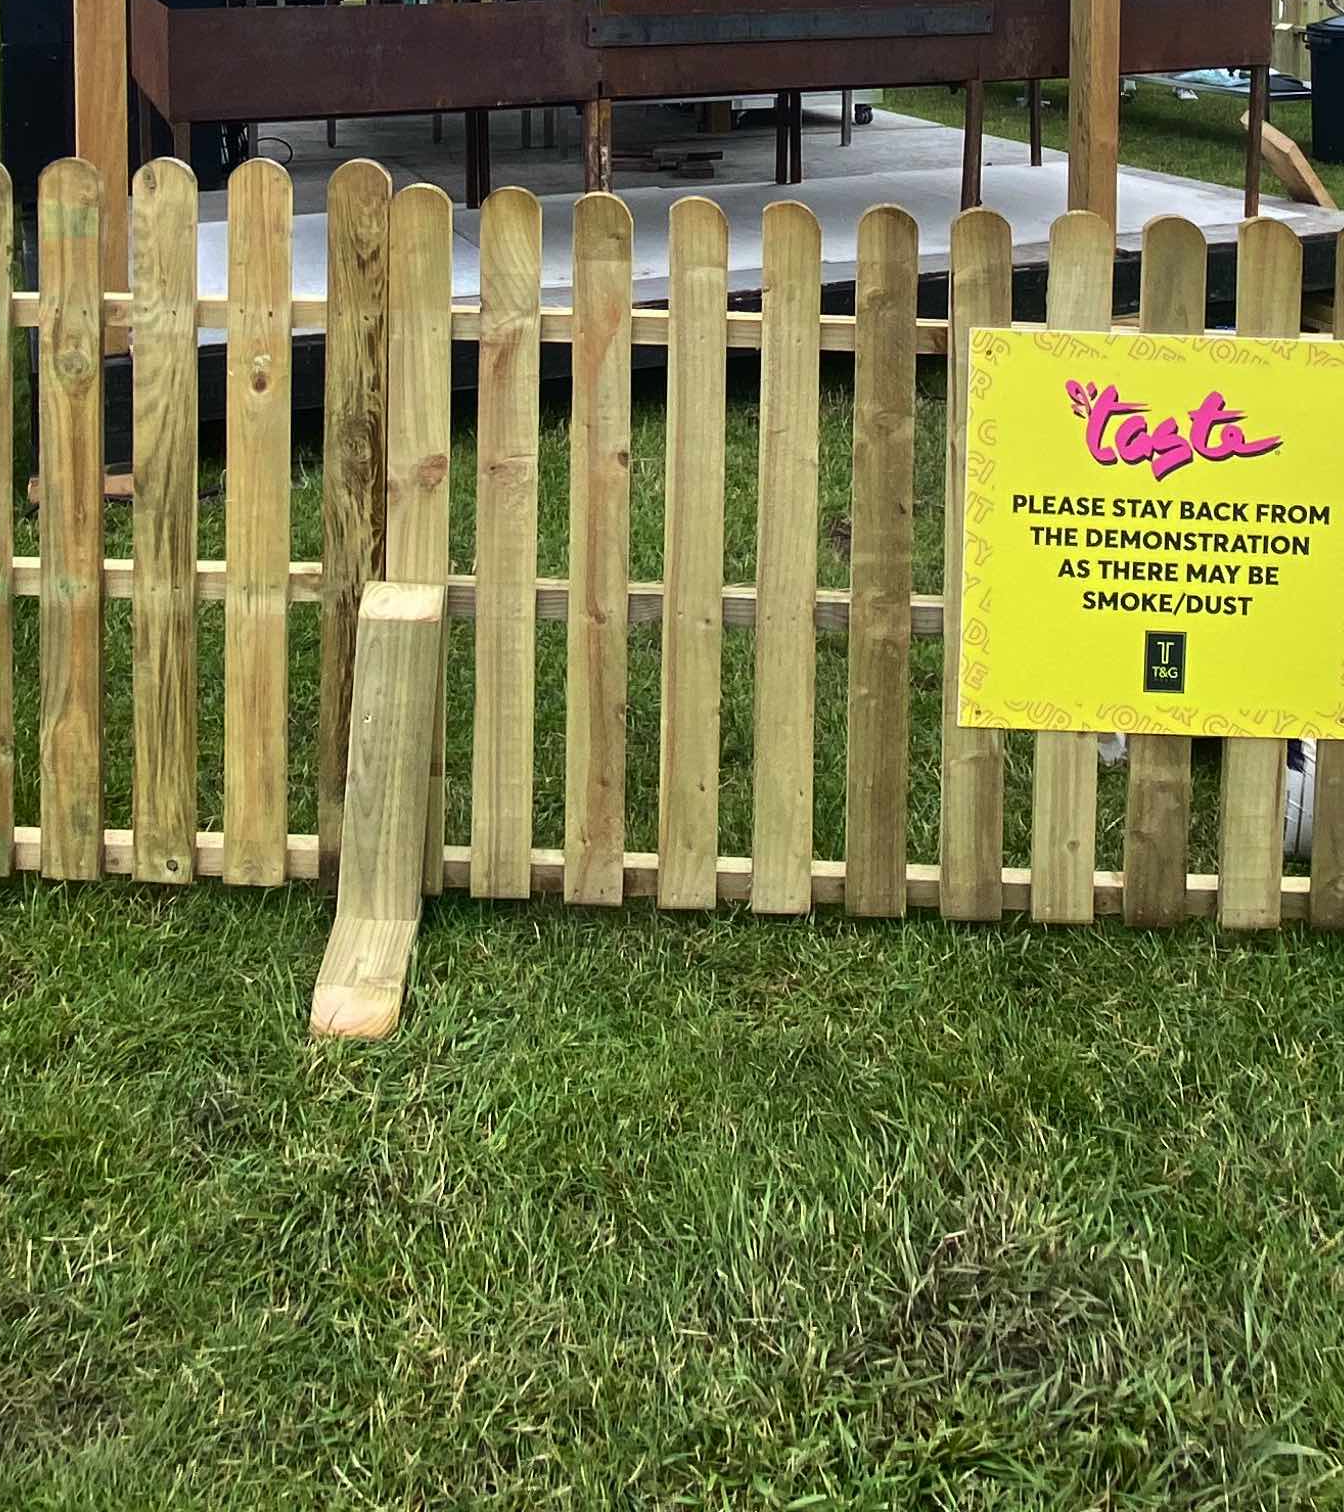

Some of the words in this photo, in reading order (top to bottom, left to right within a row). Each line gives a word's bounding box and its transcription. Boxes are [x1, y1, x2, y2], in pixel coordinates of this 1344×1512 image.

[1066, 380, 1284, 482] taste
[1012, 494, 1105, 517] PLEASE
[1111, 498, 1174, 519] STAY
[1179, 500, 1249, 522] BACK
[1256, 503, 1330, 525] FROM
[1030, 526, 1078, 547] THE
[1086, 528, 1310, 556] DEMONSTRATION
[1057, 558, 1090, 579] AS
[1097, 560, 1179, 582] THERE
[1186, 563, 1241, 585] MAY
[1248, 565, 1279, 586] BE
[1082, 591, 1253, 616] SMOKE/DUST
[1151, 666, 1178, 679] T&G
